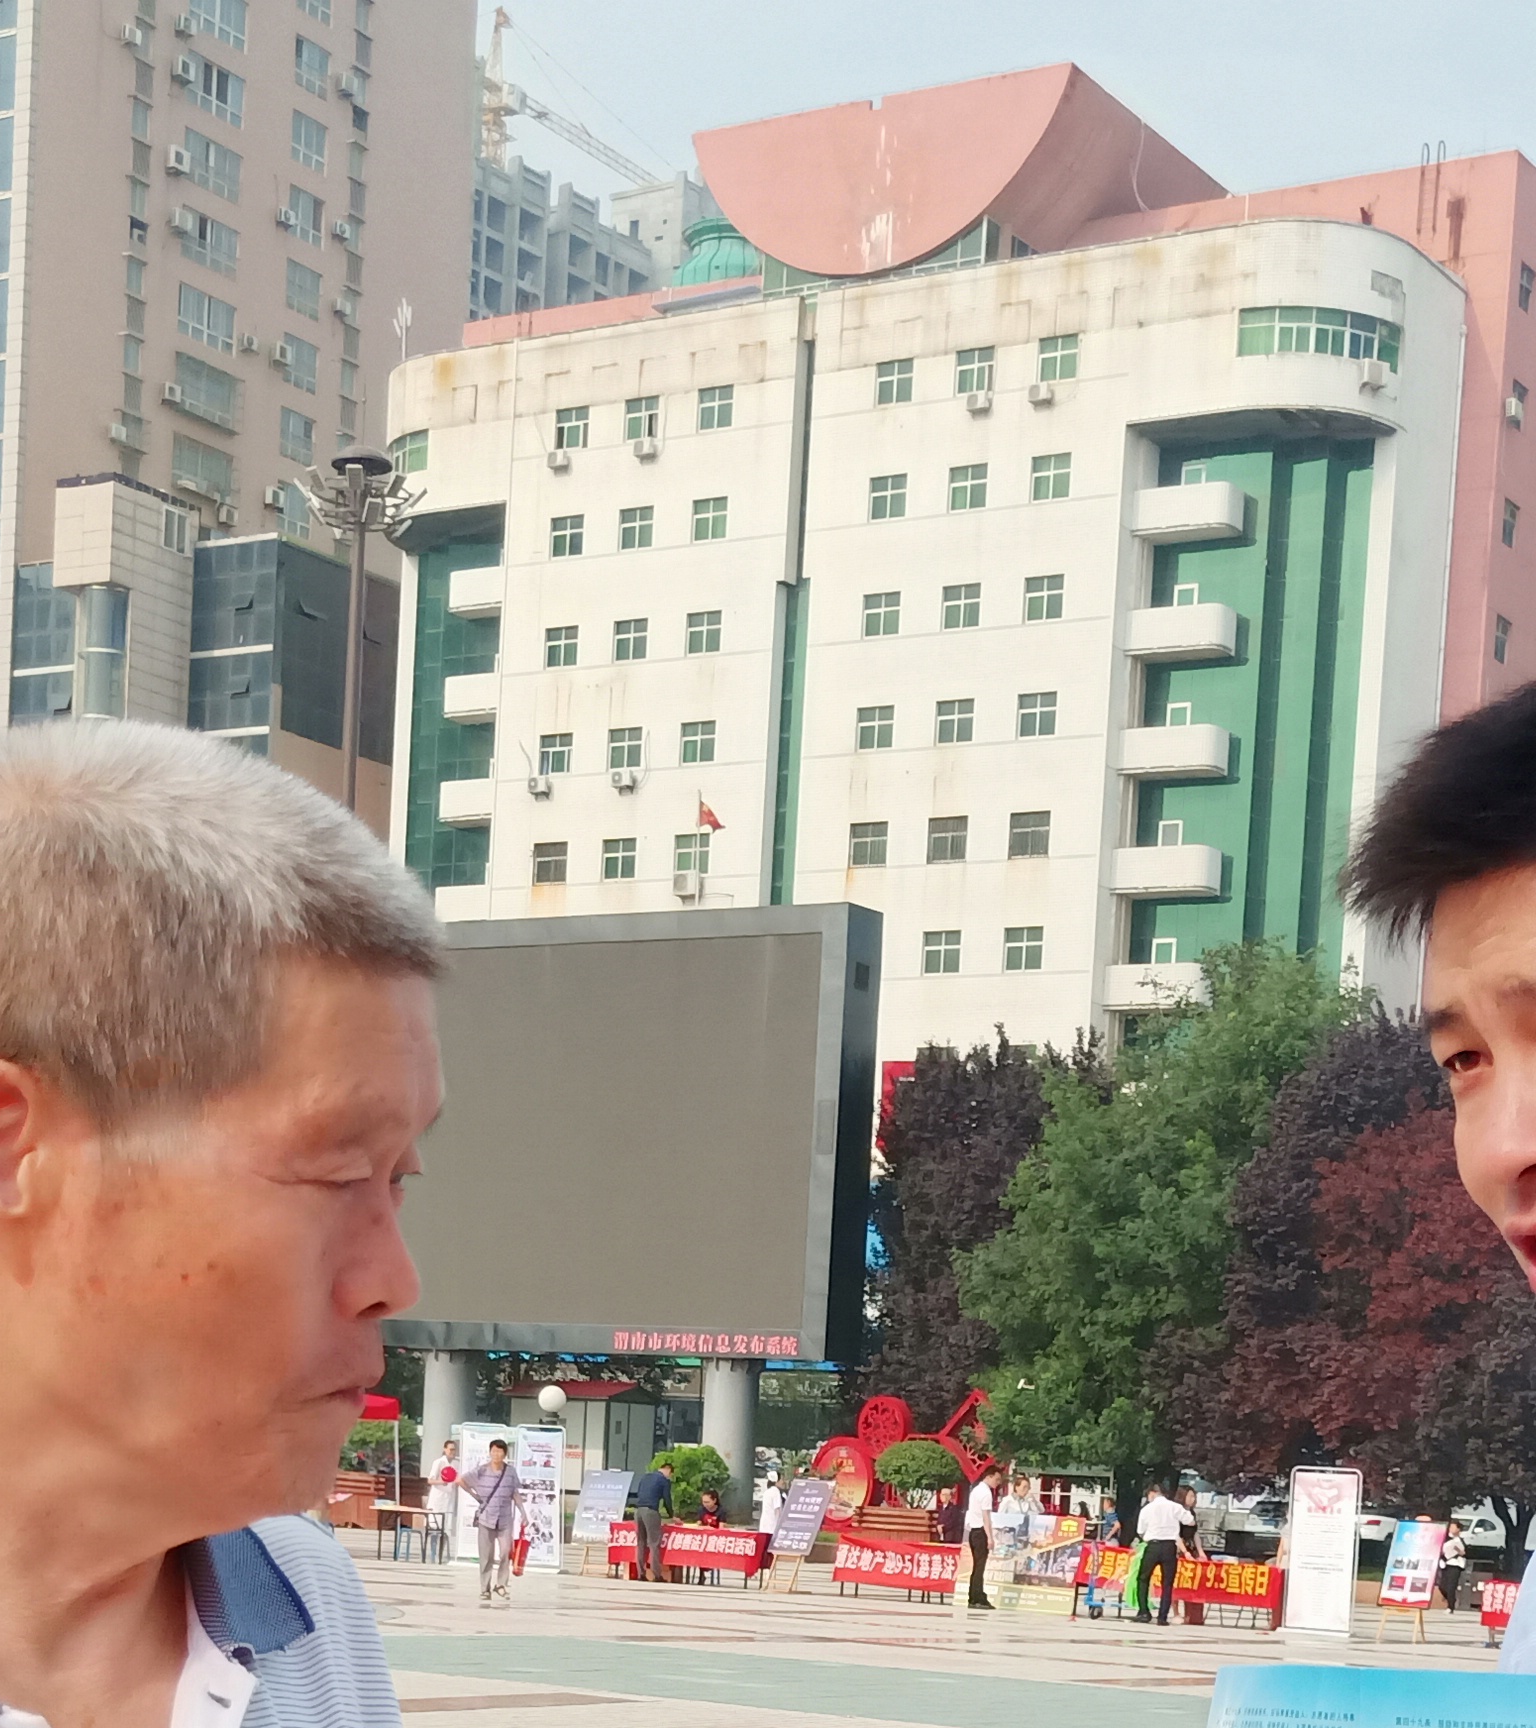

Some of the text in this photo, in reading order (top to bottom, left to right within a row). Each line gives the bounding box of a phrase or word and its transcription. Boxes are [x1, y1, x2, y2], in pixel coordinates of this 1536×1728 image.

[613, 1330, 799, 1357] 渭南市环境信息发布系统
